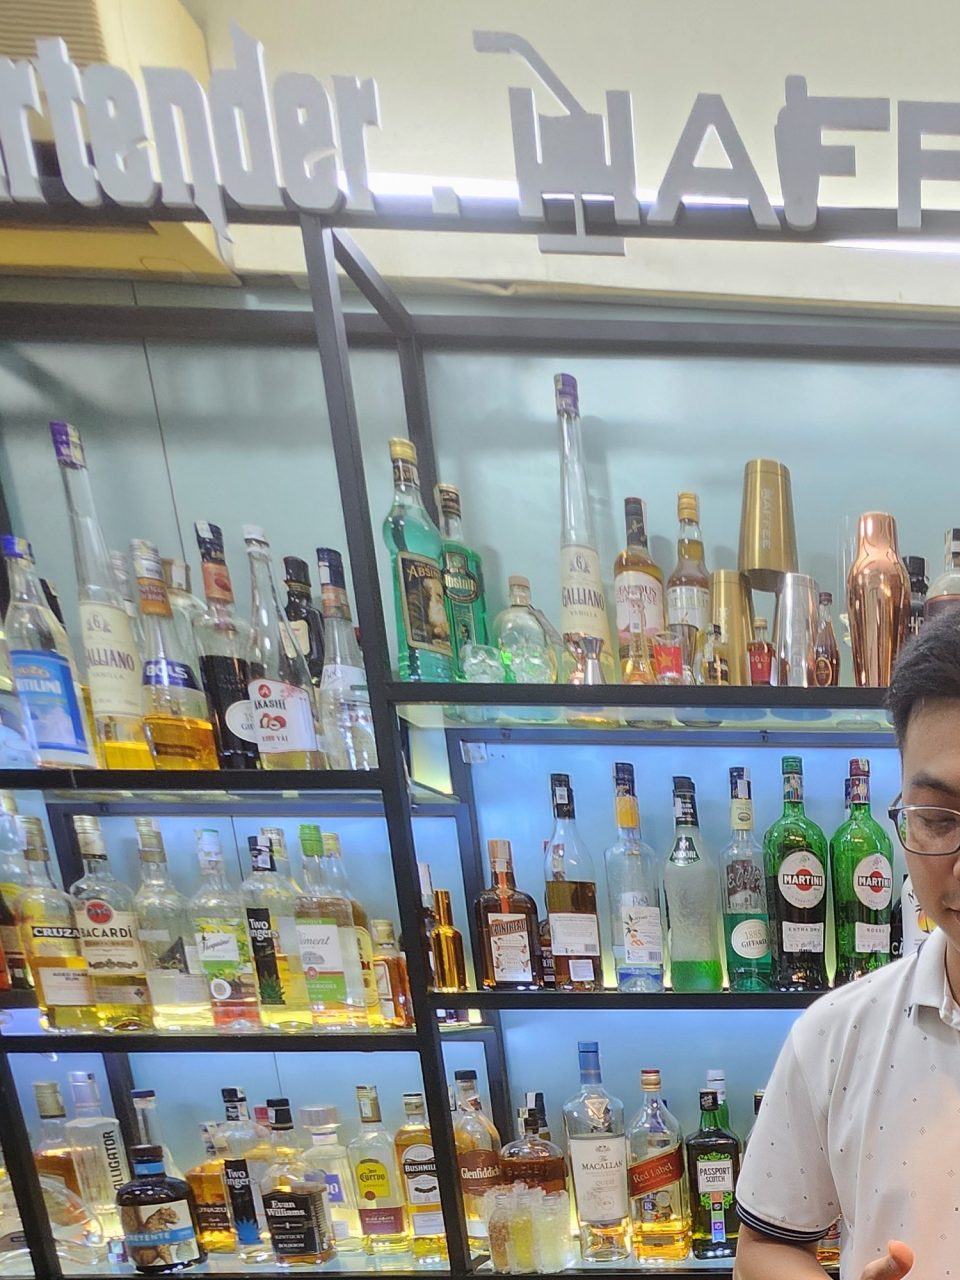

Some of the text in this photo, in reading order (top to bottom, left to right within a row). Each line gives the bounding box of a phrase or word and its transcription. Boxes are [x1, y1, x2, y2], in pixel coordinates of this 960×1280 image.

[562, 587, 605, 611] GALLIANO
[87, 649, 135, 673] ALLIANO
[783, 874, 823, 887] MARTINI
[858, 876, 891, 889] MARTINI
[249, 918, 269, 930] Two
[405, 1163, 436, 1173] BUSHMILL
[582, 1160, 624, 1171] MACALLAN
[226, 1169, 246, 1178] Two
[360, 1172, 386, 1182] Cuervo
[633, 1162, 673, 1183] Red Label
[700, 1166, 731, 1177] PASSPORT
[271, 1200, 296, 1209] Evan
